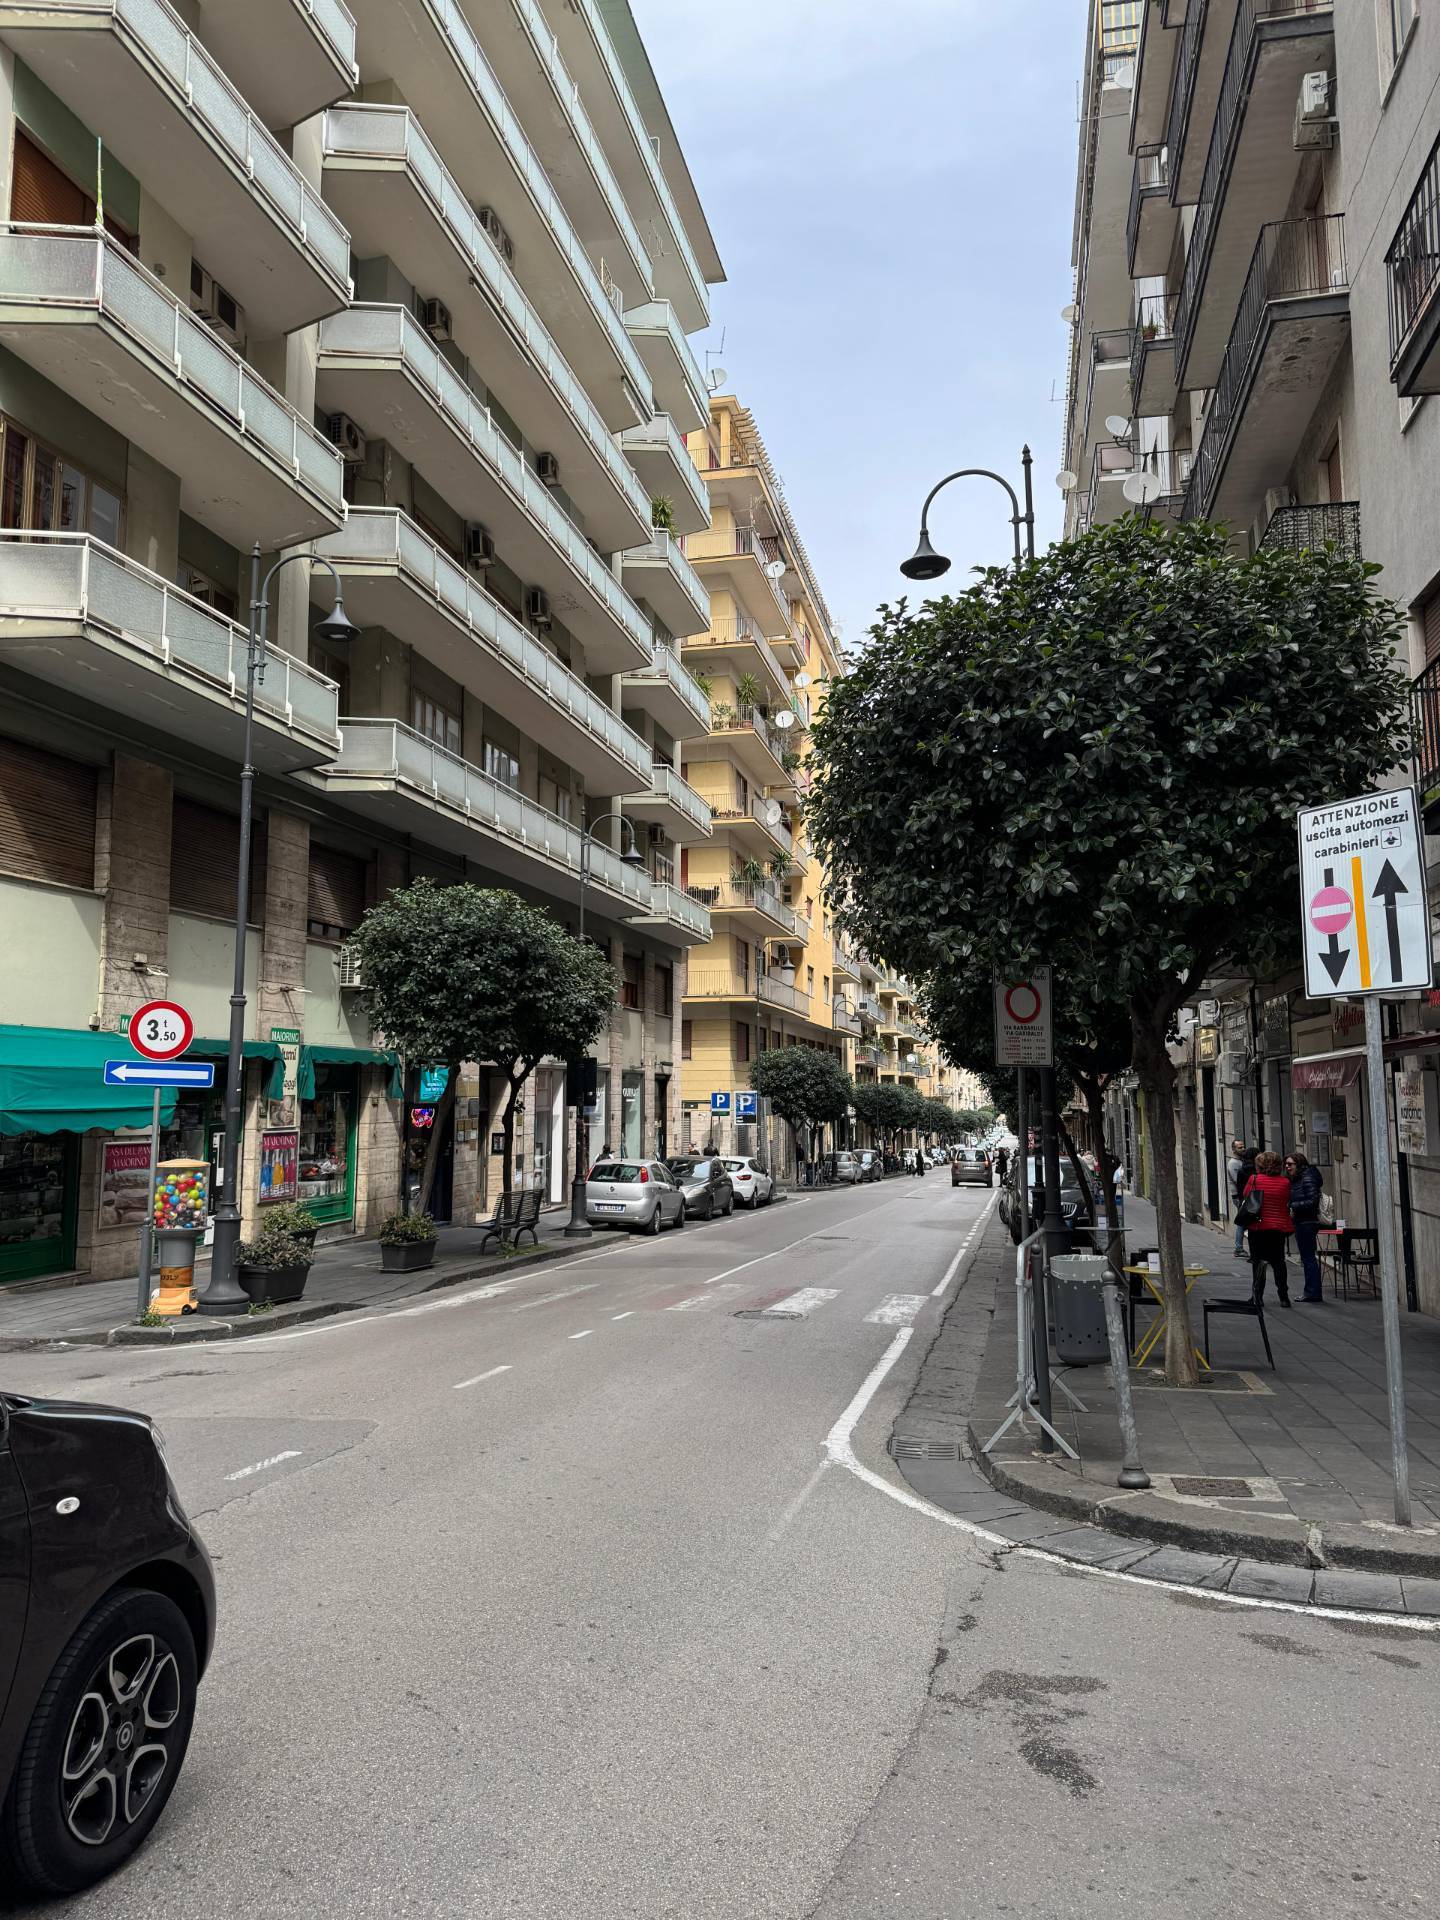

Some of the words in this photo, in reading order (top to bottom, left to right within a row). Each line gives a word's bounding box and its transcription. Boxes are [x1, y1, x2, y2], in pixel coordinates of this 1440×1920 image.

[1311, 796, 1399, 826] ATTENZIONE
[1305, 827, 1342, 842] uscita
[1345, 810, 1409, 834] automezzi
[1314, 835, 1379, 858] carabinieri
[271, 1030, 300, 1043] MAIORINO
[716, 1094, 725, 1107] P
[739, 1095, 752, 1111] P
[263, 1135, 297, 1147] MAIORINO
[112, 1156, 148, 1167] MAIORINO
